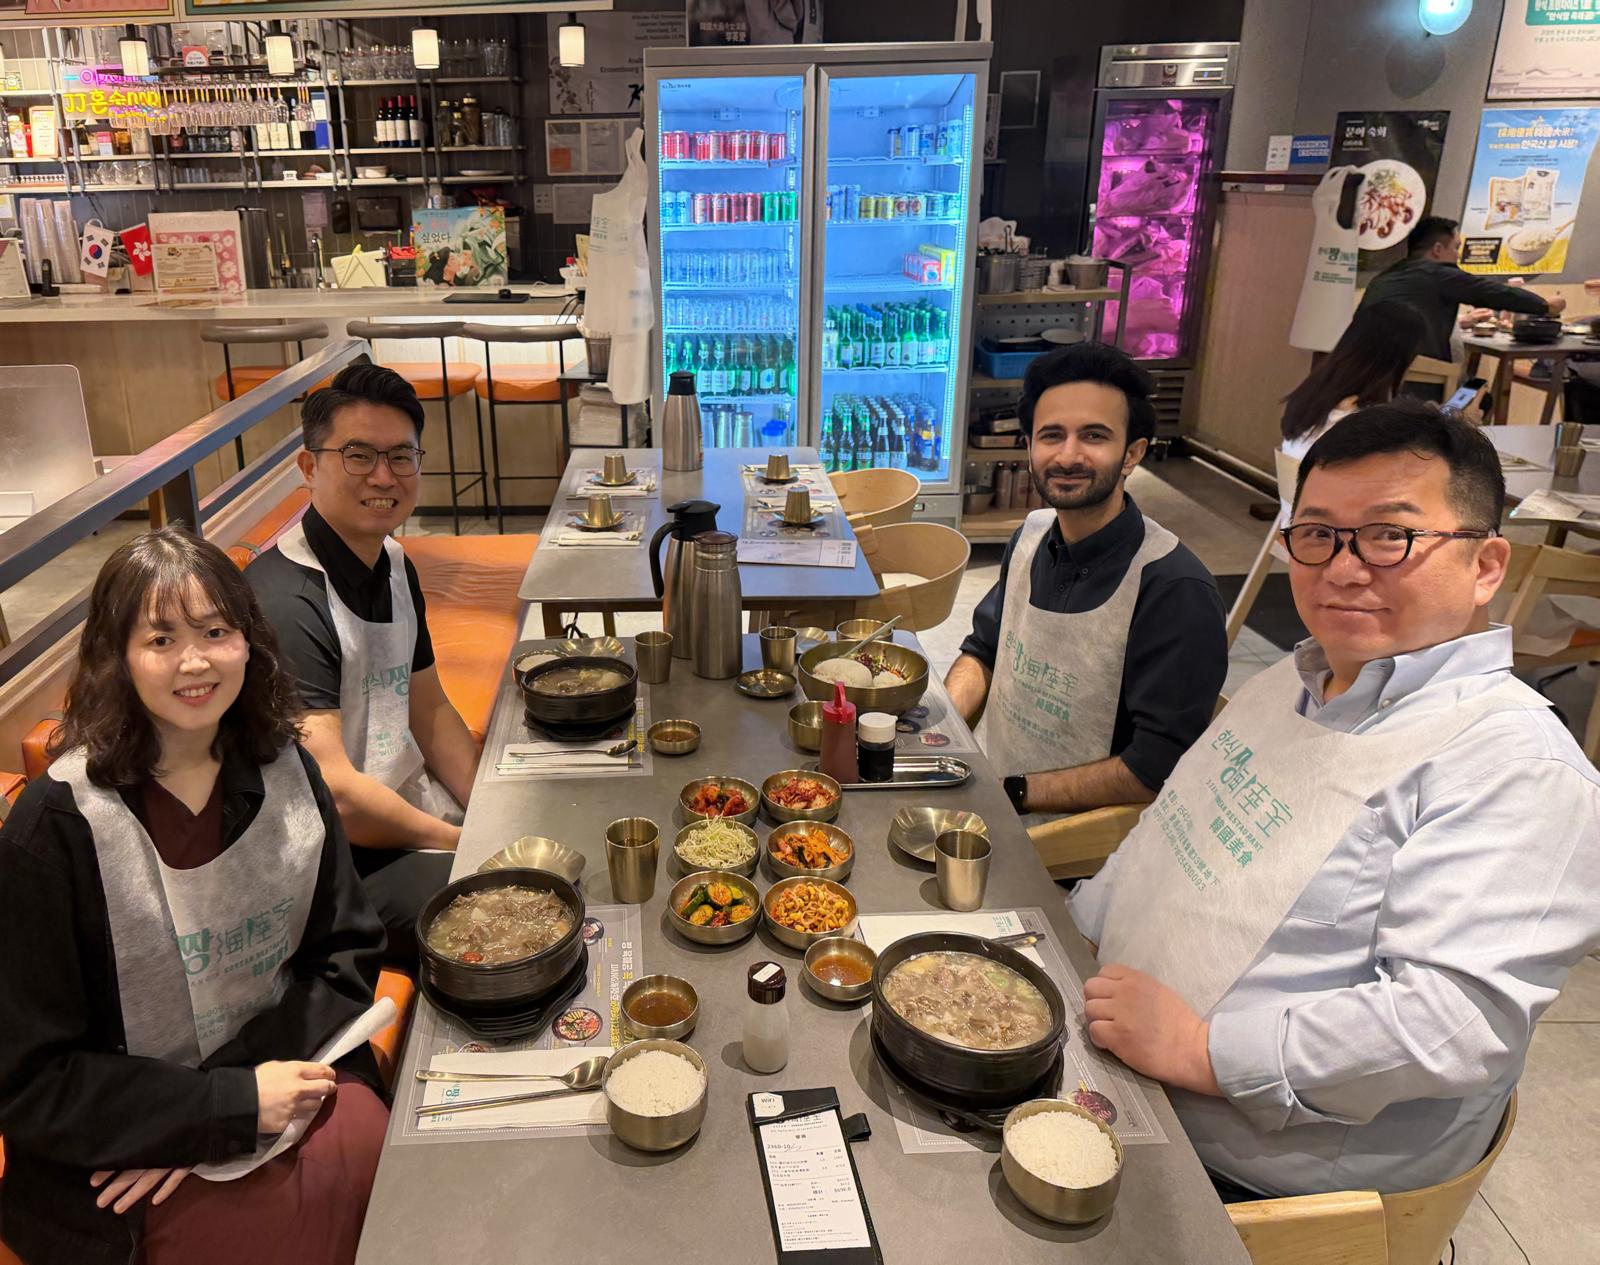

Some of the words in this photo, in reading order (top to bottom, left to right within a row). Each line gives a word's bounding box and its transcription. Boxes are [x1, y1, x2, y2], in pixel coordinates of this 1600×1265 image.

[421, 232, 452, 244] 싶었다
[1209, 816, 1253, 868] 韓國美食
[1226, 810, 1264, 853] RESTAURANT
